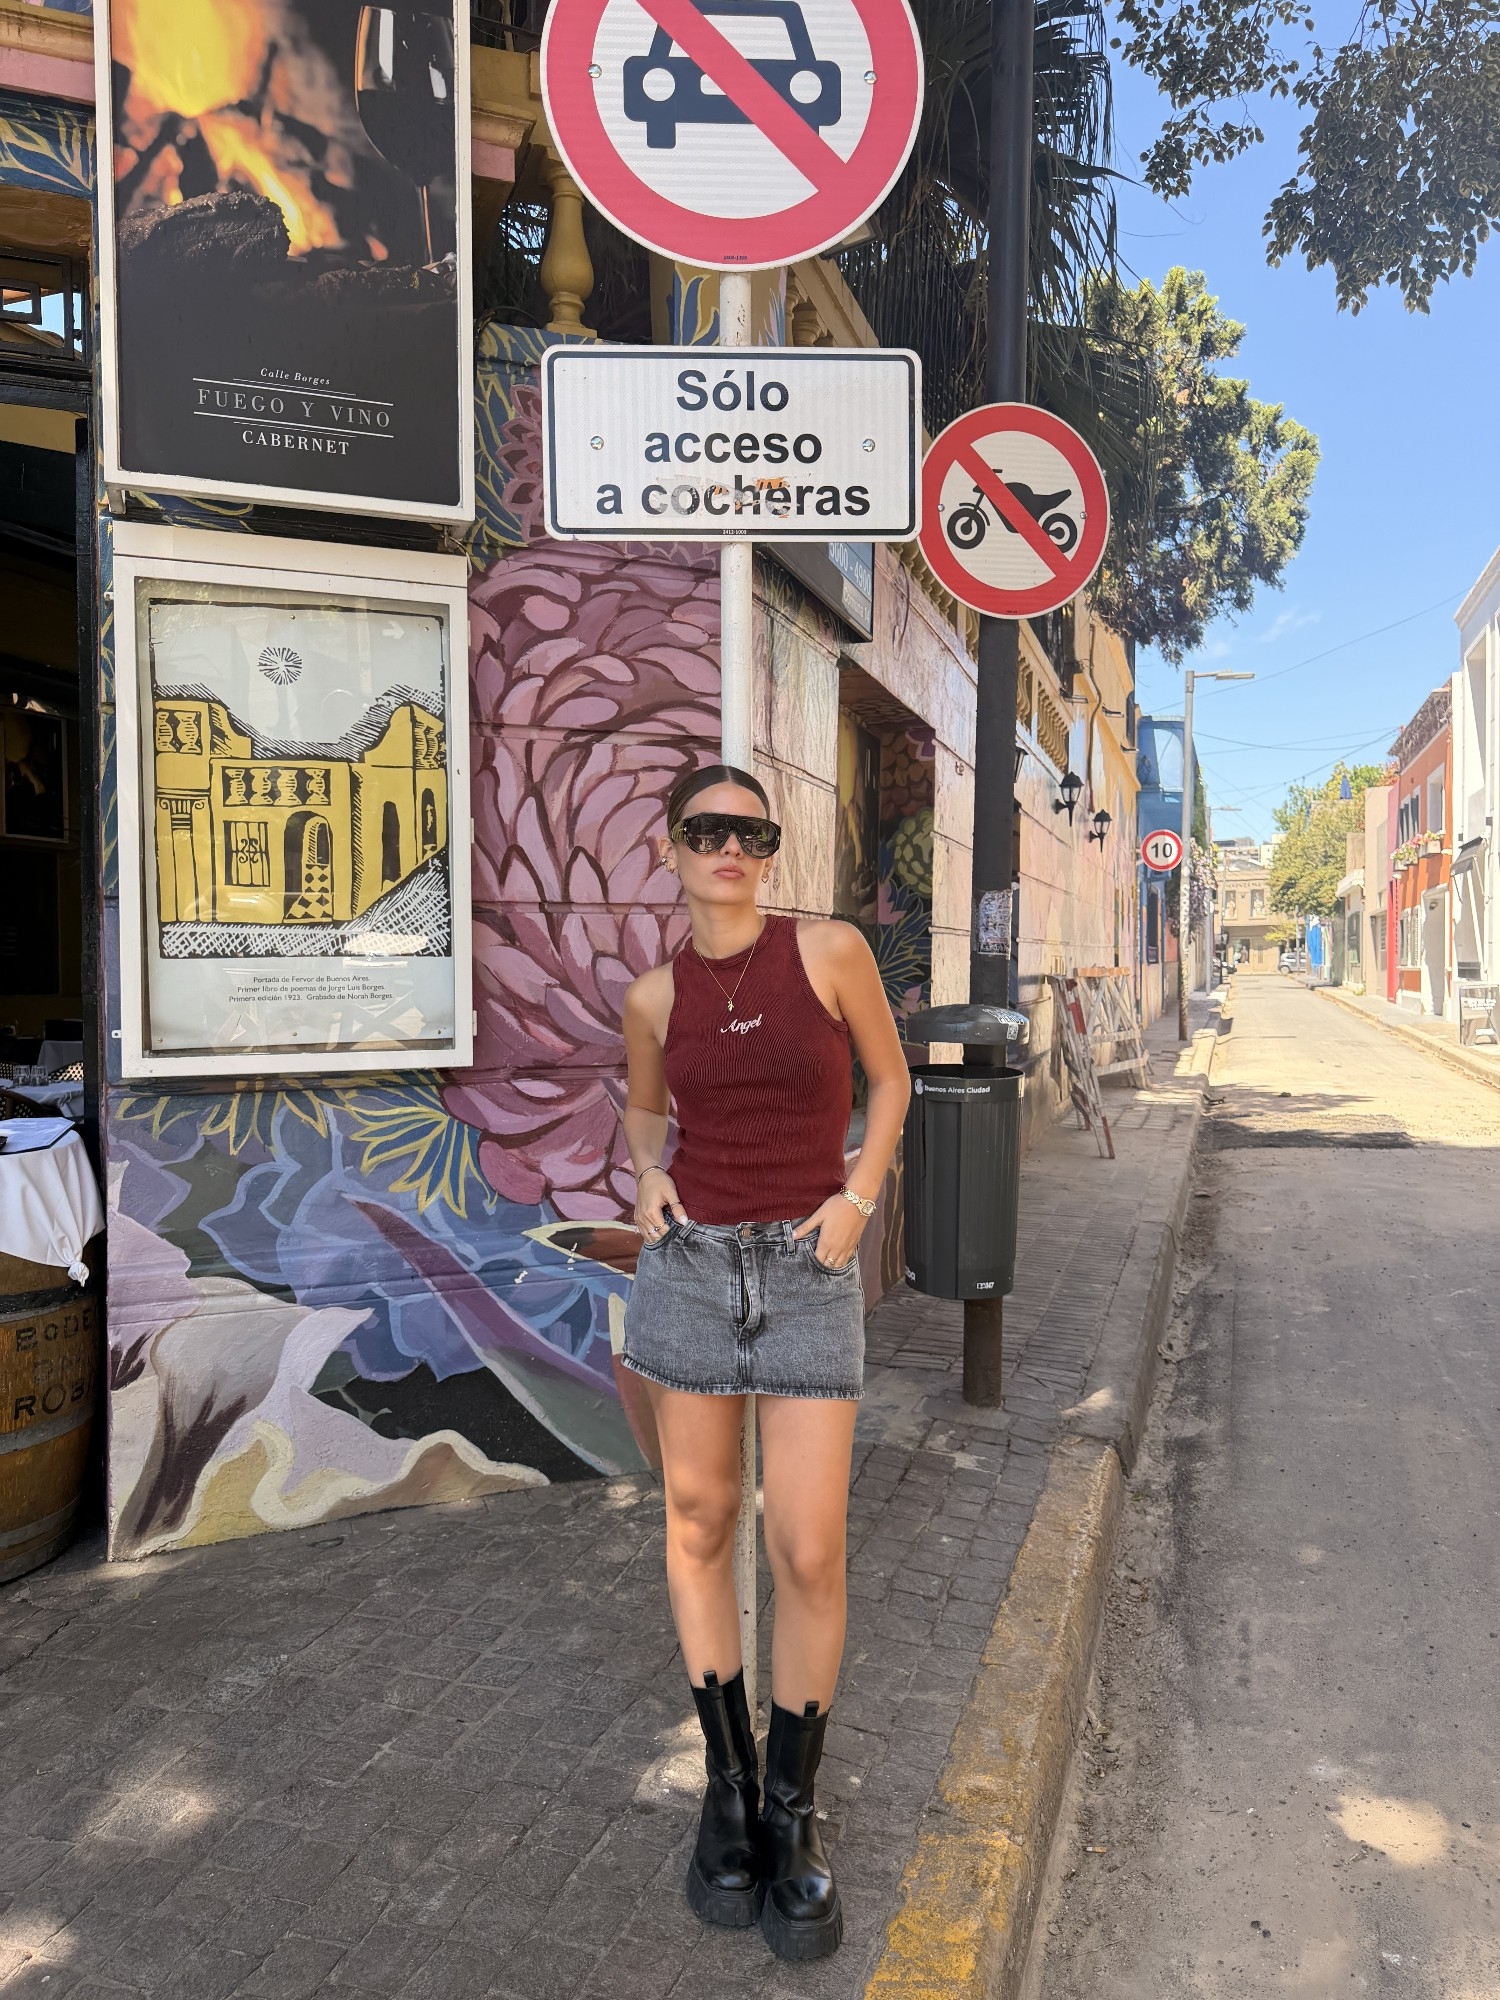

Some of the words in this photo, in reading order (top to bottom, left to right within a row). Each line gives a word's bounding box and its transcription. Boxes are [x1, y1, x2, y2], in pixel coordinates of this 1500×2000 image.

[260, 367, 289, 379] Calle
[294, 372, 331, 386] Borges
[676, 369, 790, 412] Sólo
[197, 388, 284, 414] FUEGO
[301, 401, 315, 418] Y
[330, 404, 390, 428] VINO
[242, 430, 350, 455] CABERNET
[644, 432, 822, 464] acceso
[596, 483, 623, 516] a
[641, 474, 871, 516] cocheras
[854, 561, 871, 596] 4900
[843, 586, 864, 618] Comuna
[1151, 842, 1173, 859] 10
[291, 975, 314, 983] Fervor
[328, 984, 346, 993] Jorge
[362, 983, 386, 992] Borges.
[228, 995, 256, 1003] Primera
[257, 994, 283, 1002] edición
[306, 993, 336, 1001] Grabado
[720, 1013, 763, 1035] Angel
[924, 1084, 947, 1093] Buenos
[947, 1086, 965, 1094] Aires
[966, 1085, 991, 1094] Ciudad
[15, 1306, 92, 1353] BODE
